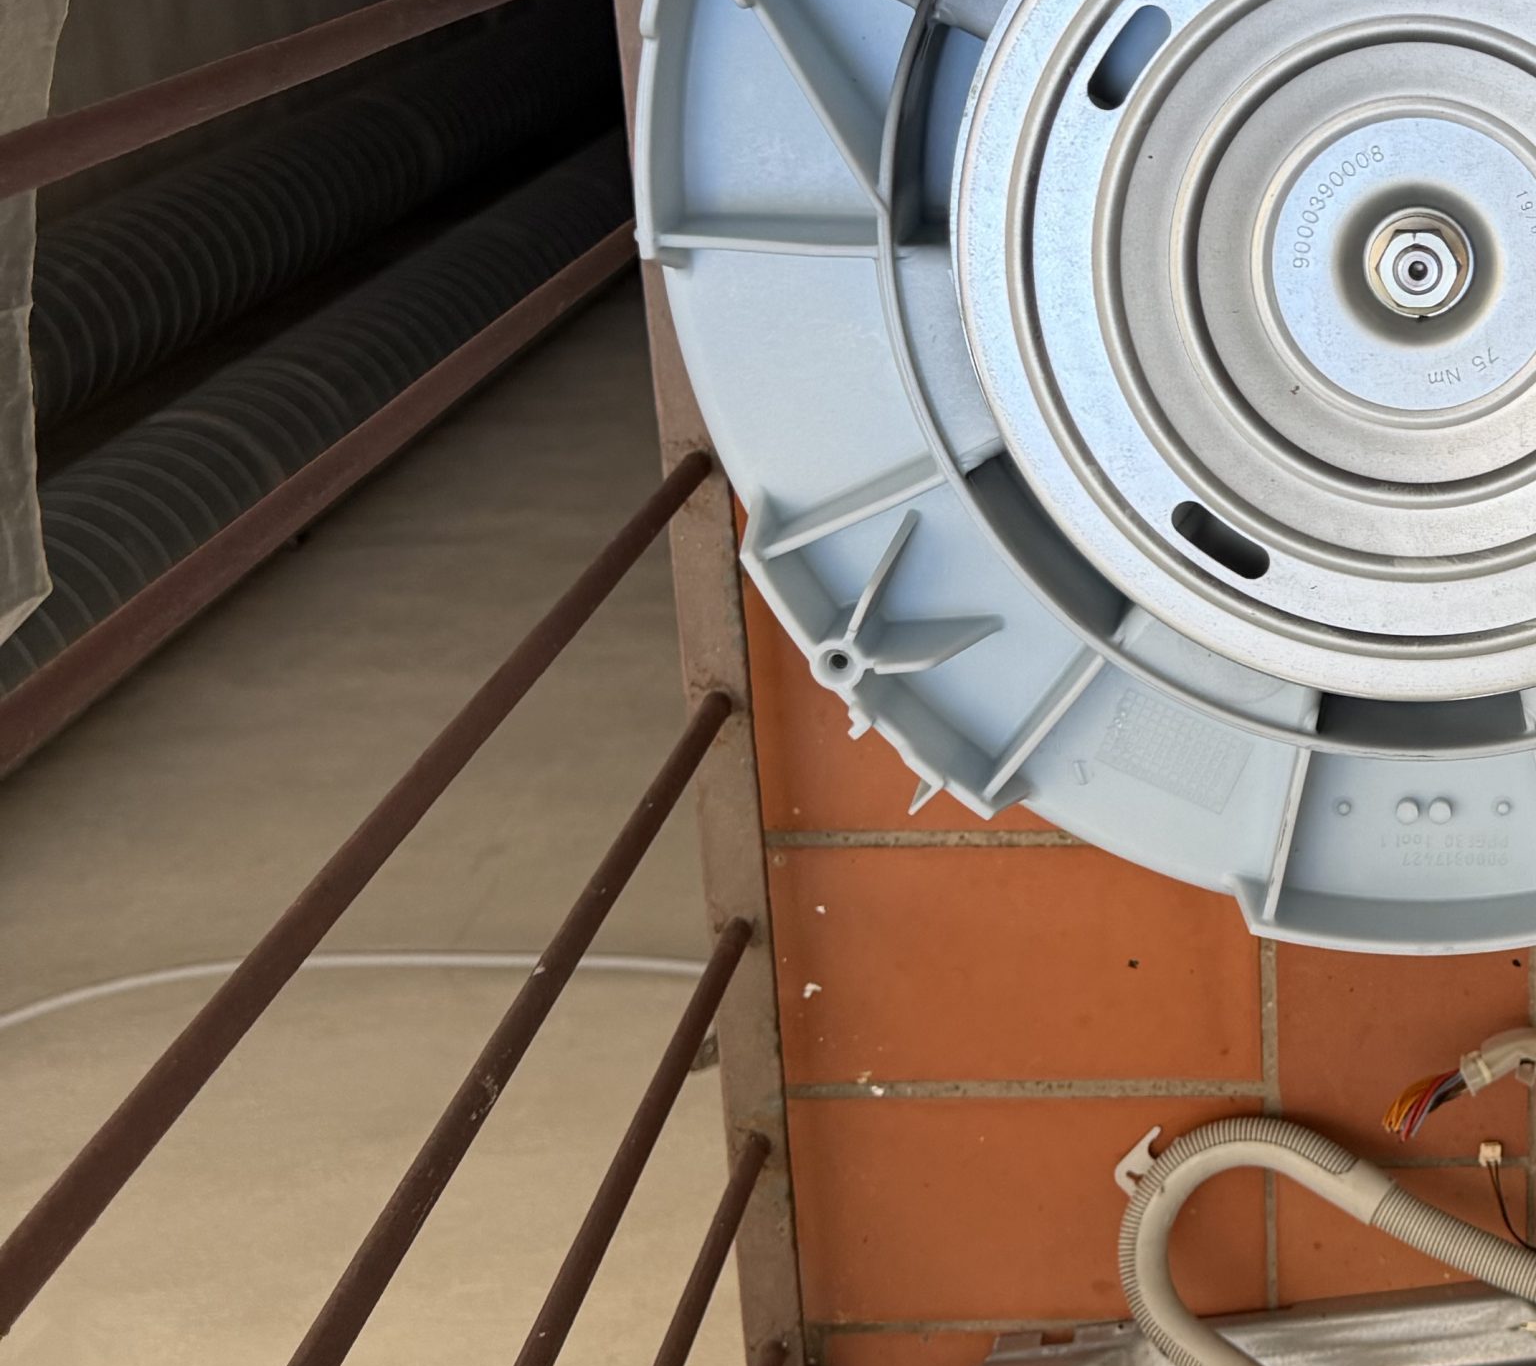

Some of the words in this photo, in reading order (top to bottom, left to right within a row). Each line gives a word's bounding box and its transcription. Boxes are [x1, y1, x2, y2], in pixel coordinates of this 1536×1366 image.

[1292, 144, 1385, 270] 9000390008
[1471, 346, 1500, 373] 75
[1427, 366, 1462, 386] Nm
